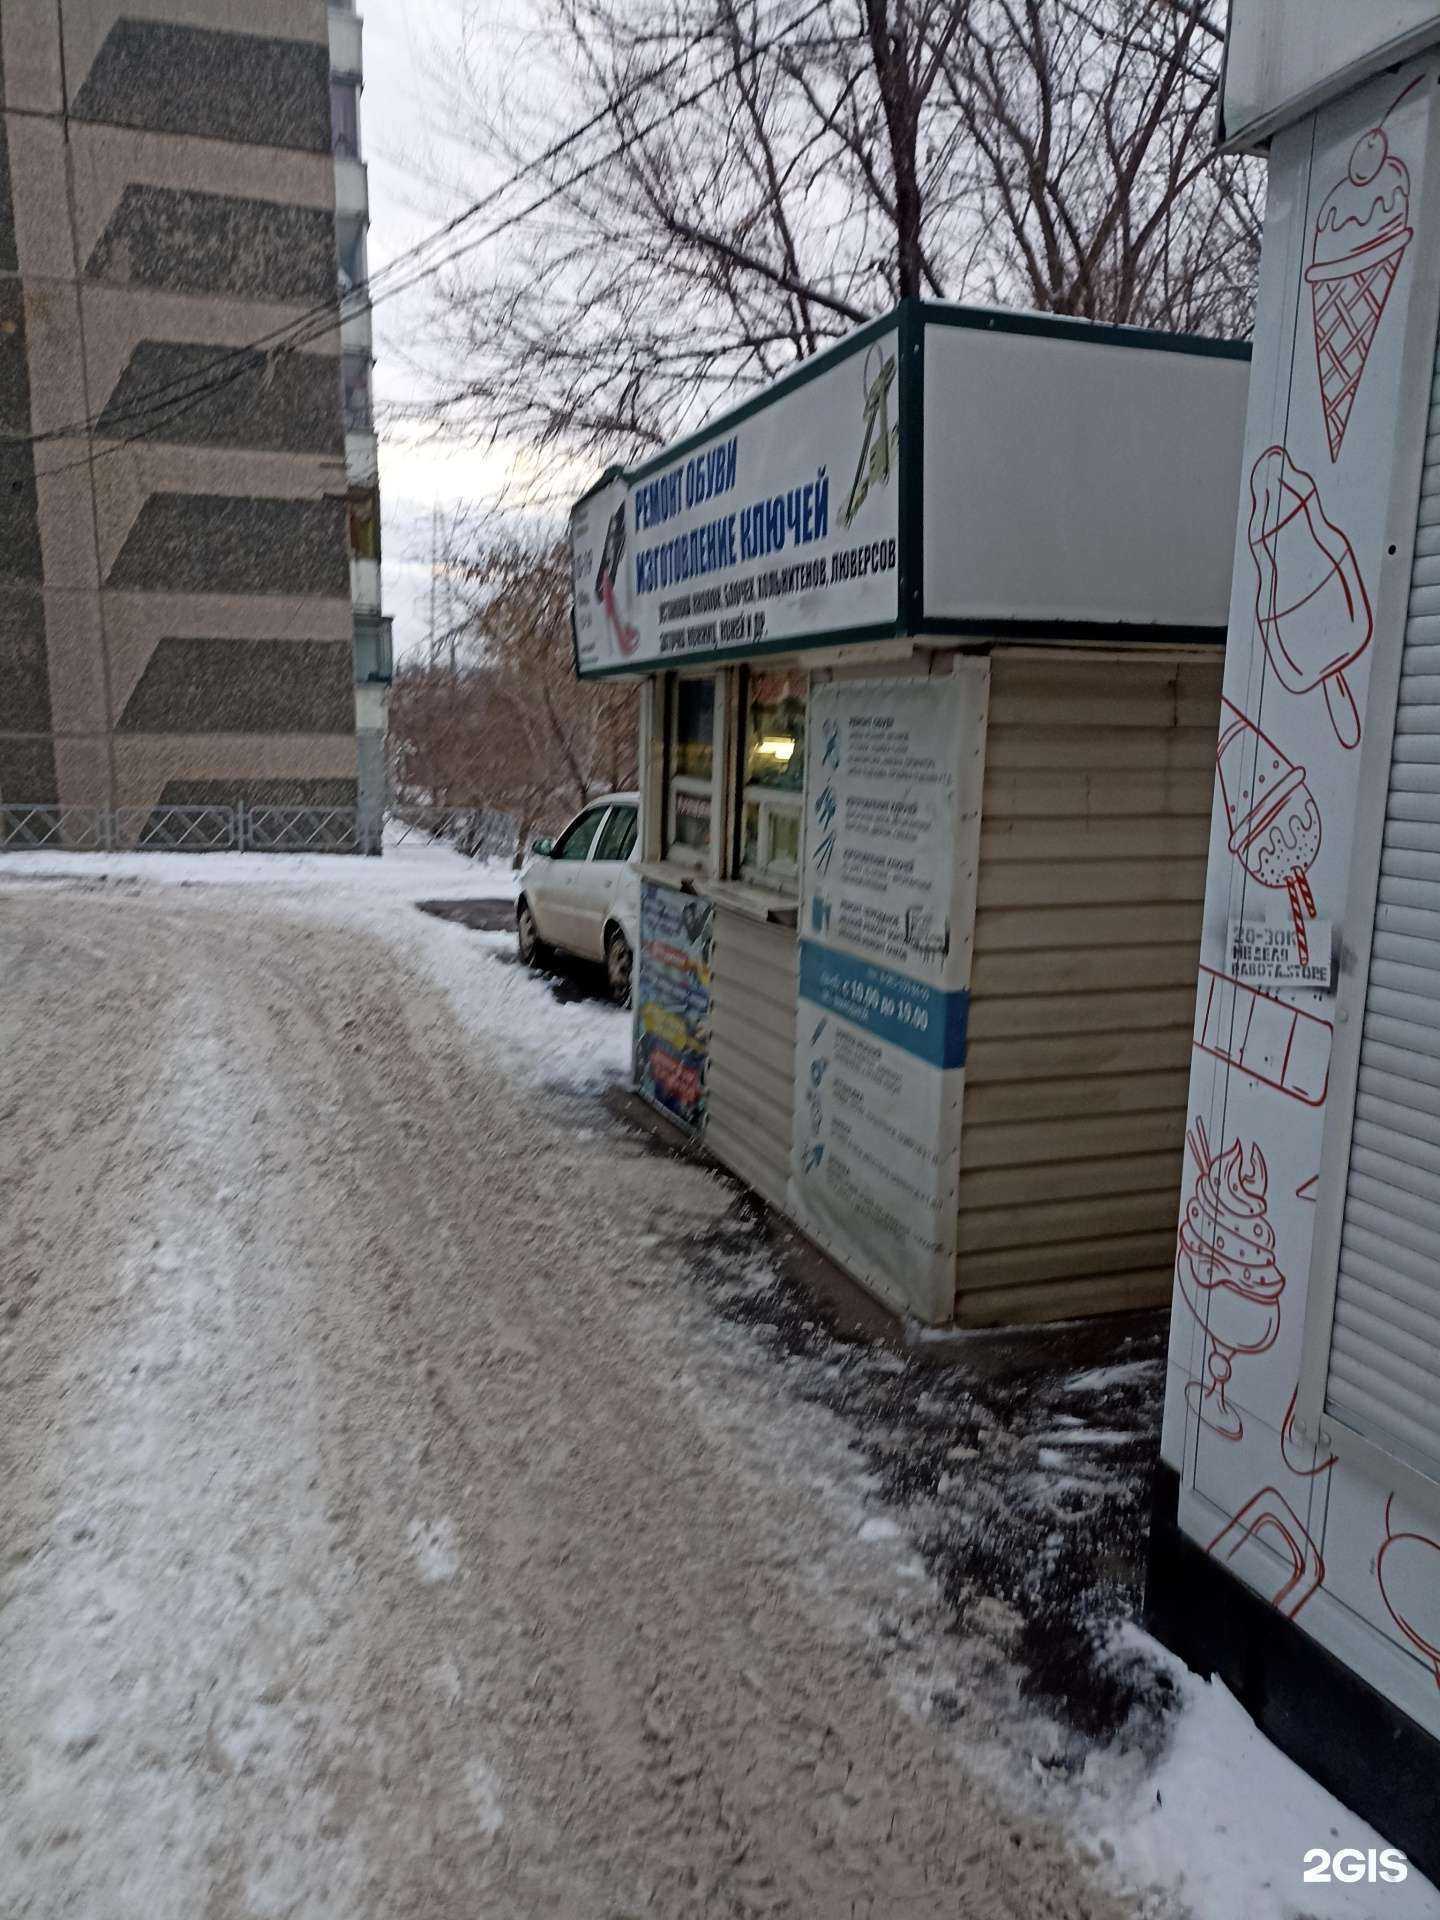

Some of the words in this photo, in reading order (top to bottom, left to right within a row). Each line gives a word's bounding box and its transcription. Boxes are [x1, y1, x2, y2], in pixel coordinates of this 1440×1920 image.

[635, 468, 684, 532] РЕМОНТ
[685, 436, 738, 510] ОБУВИ
[636, 514, 738, 597] ИЗГОТОВЛЕНИЕ
[740, 464, 830, 562] КЛЮЧЕЙ
[830, 537, 897, 583] ЛЮВЕРСОВ
